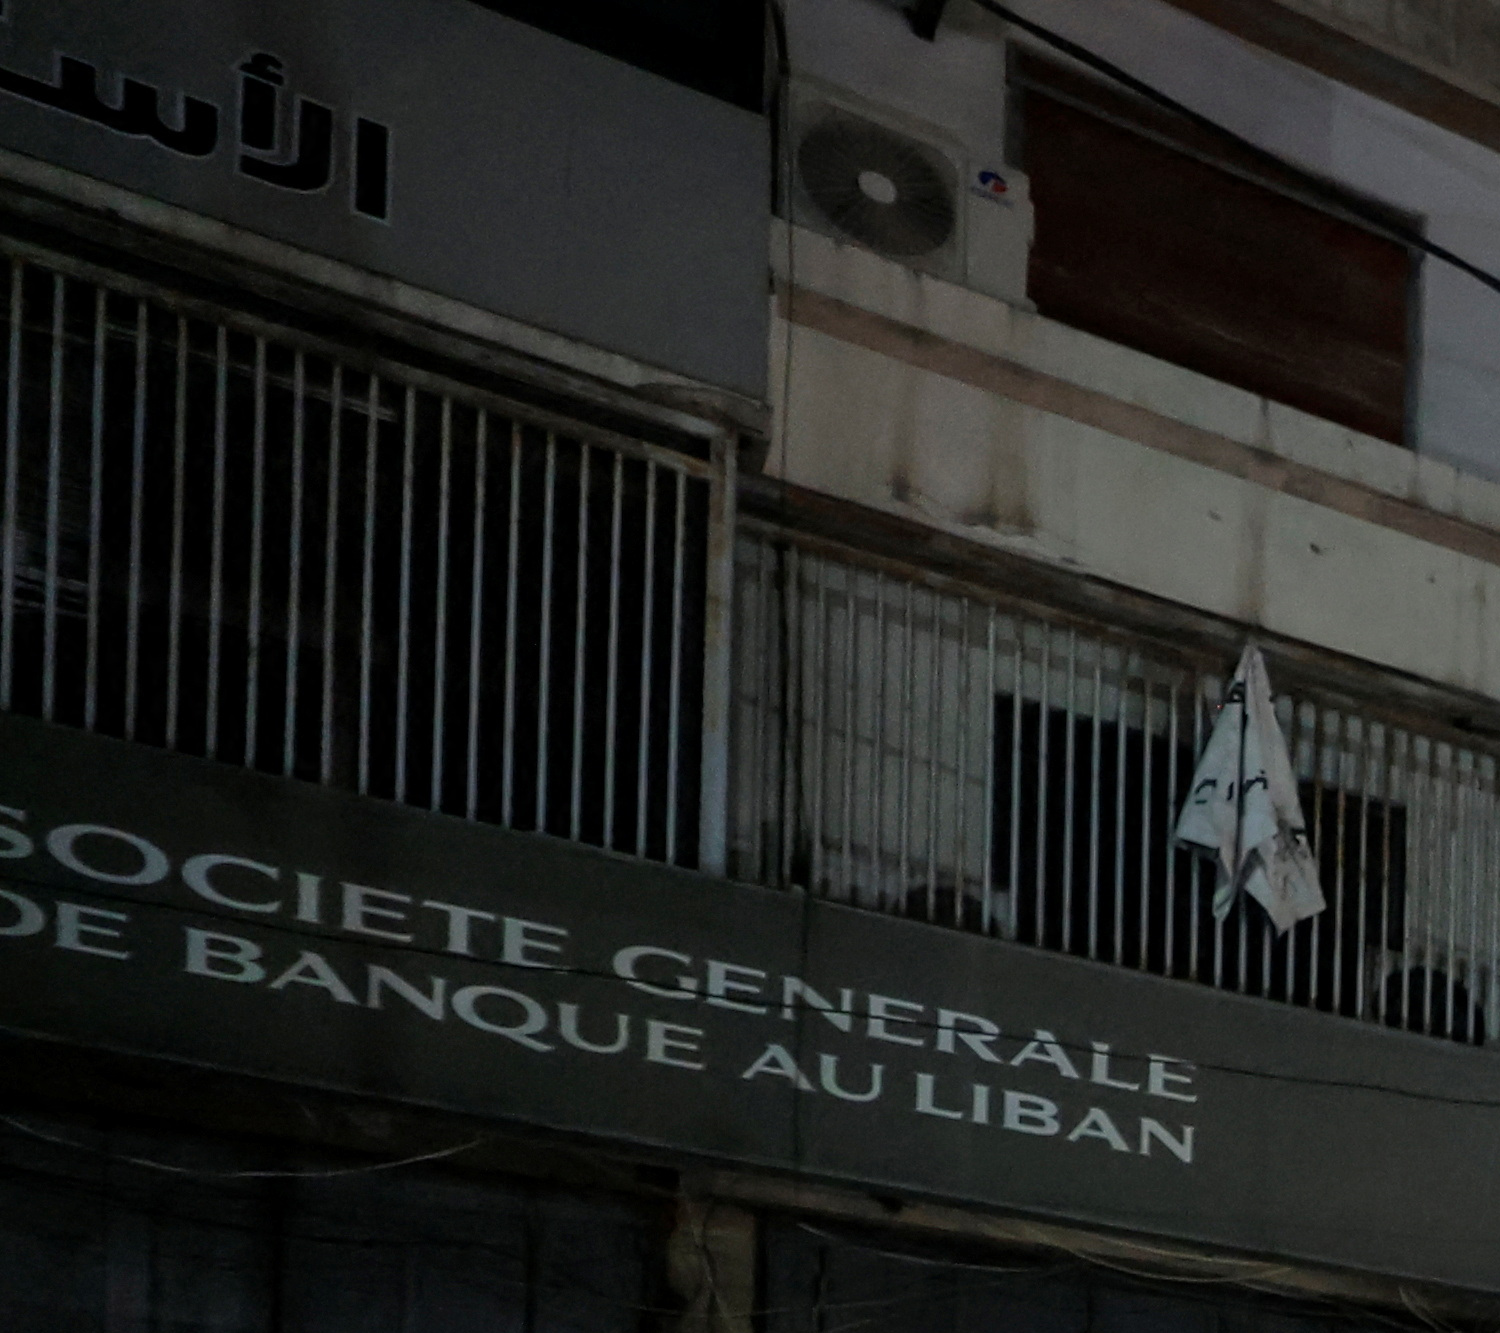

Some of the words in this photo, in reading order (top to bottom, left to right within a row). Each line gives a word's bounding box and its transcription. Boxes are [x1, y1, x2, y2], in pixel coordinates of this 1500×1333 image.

[0, 50, 391, 221] الأس
[184, 926, 706, 1070] BANQUE
[741, 1042, 884, 1102] AU
[915, 1072, 1195, 1163] LIBAN
[612, 945, 1198, 1103] GENERALE
